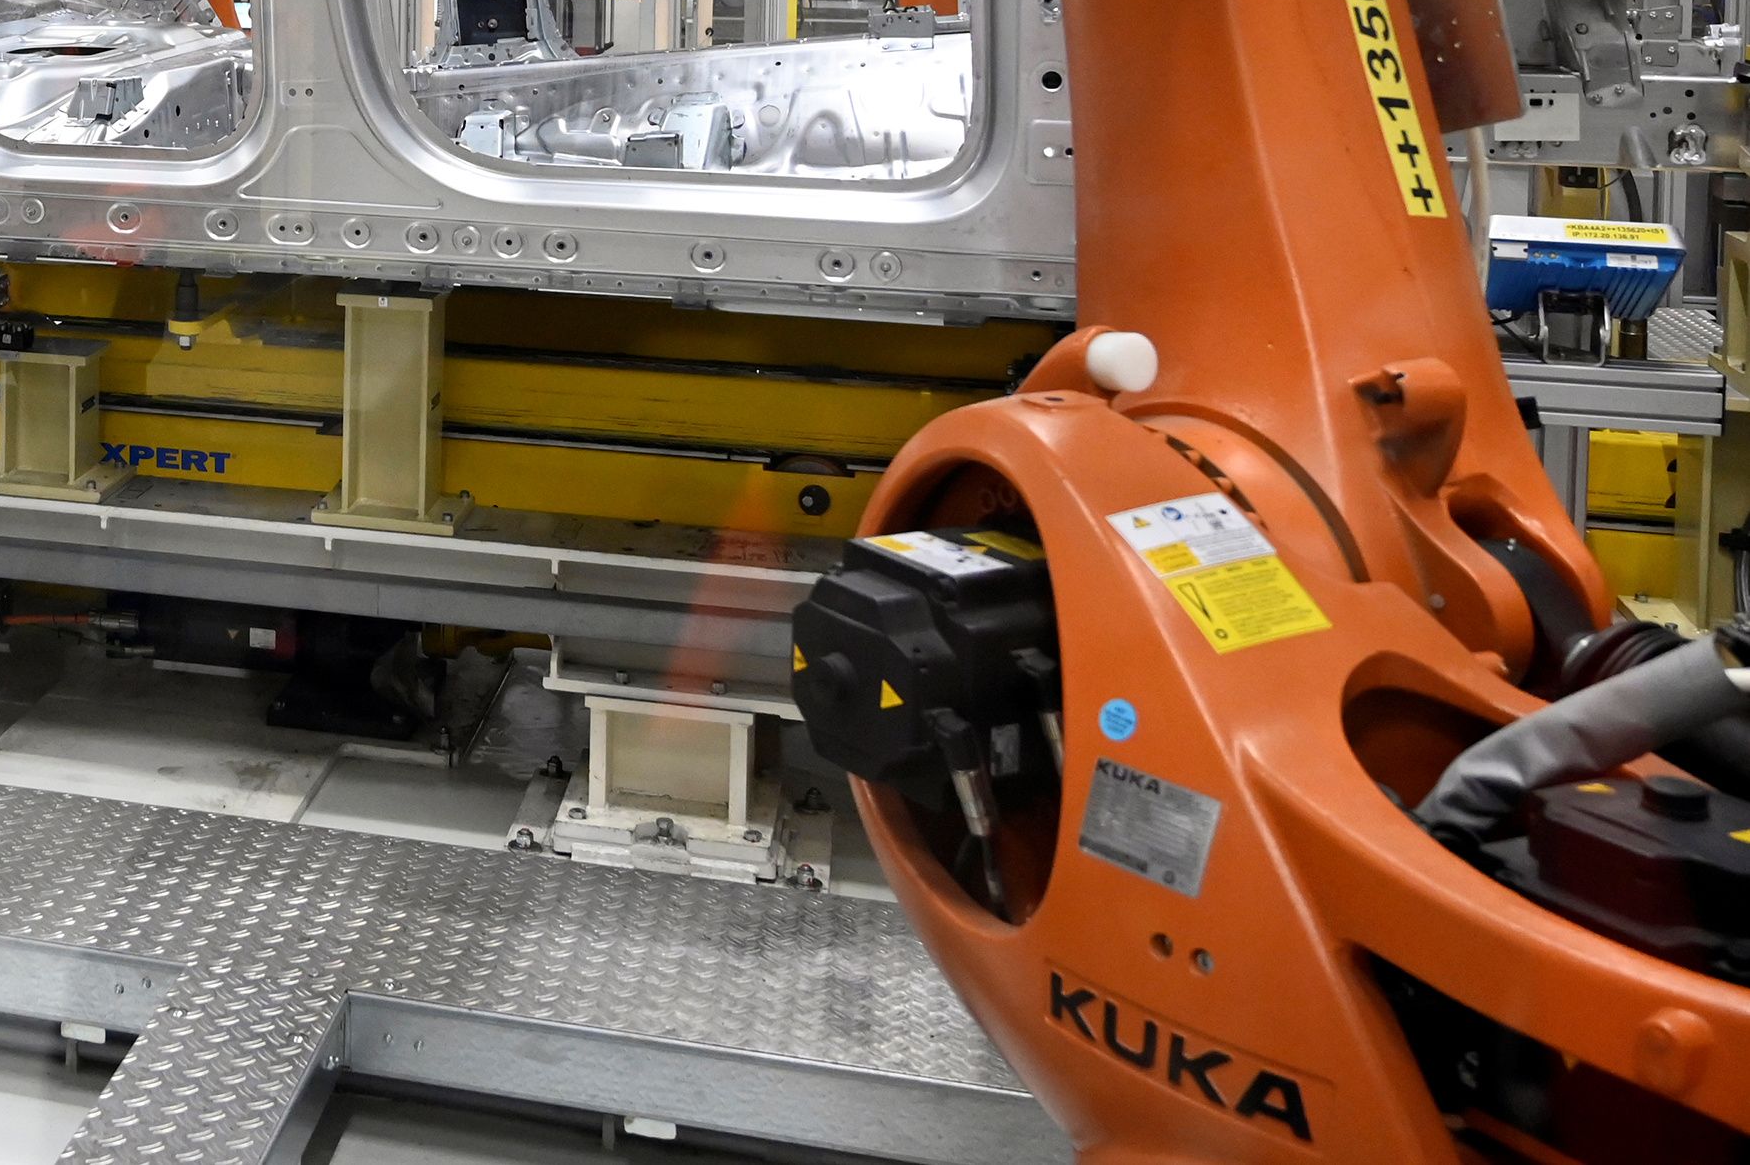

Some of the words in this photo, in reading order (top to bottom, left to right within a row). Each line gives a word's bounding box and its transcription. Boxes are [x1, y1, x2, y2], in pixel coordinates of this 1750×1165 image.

[100, 442, 231, 474] XPERT
[1097, 760, 1161, 795] KUKA
[1051, 971, 1312, 1141] KUKA
